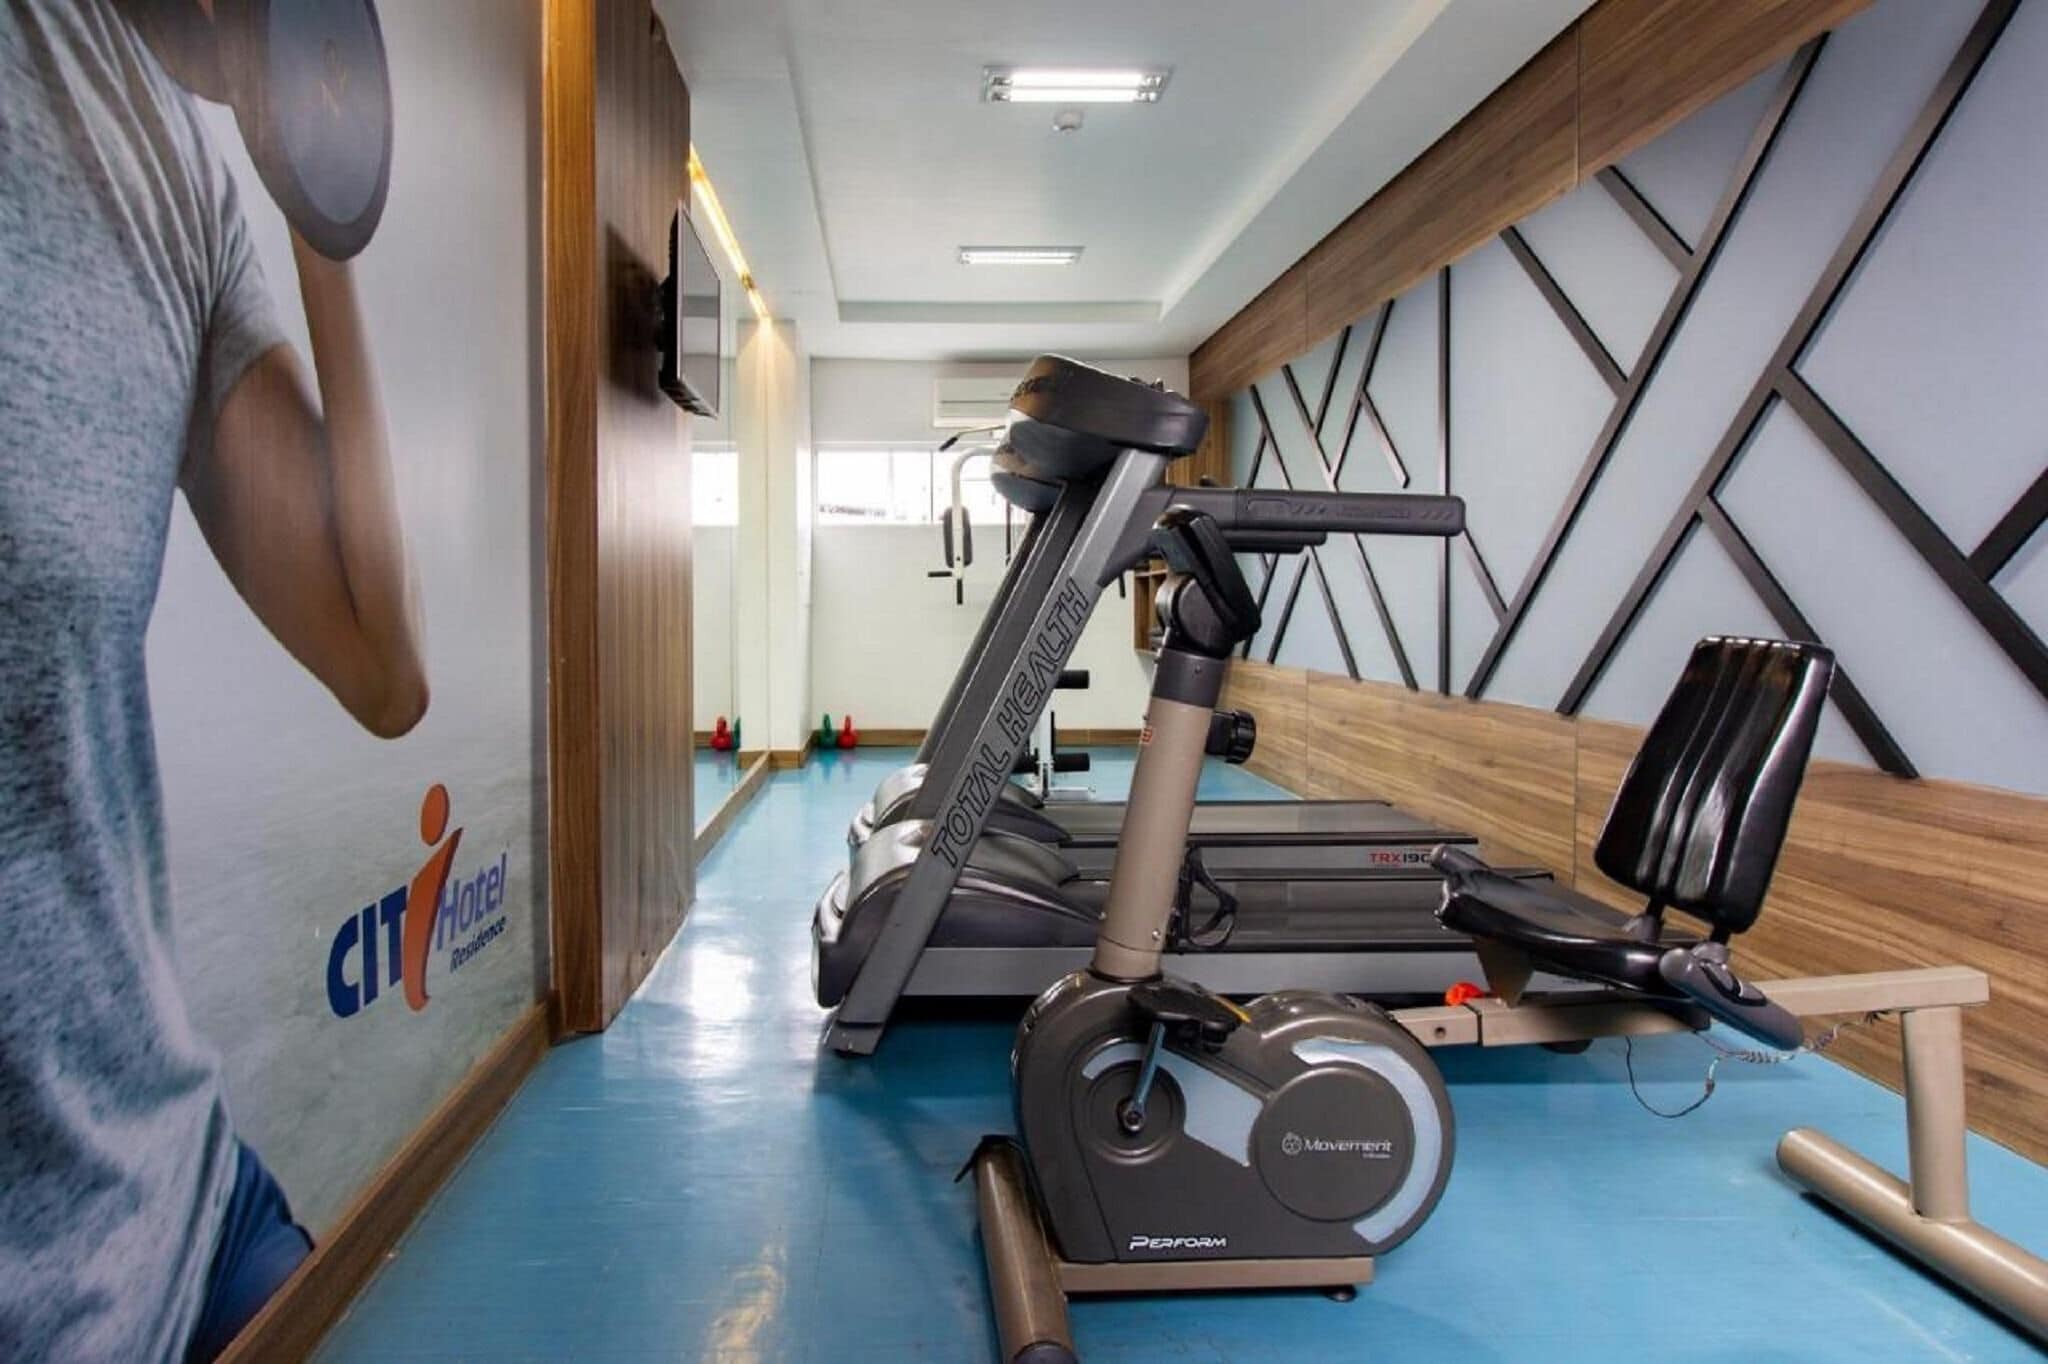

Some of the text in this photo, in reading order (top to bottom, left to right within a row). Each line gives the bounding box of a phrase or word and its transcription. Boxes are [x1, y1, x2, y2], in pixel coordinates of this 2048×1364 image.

[931, 576, 1089, 868] TOTAL HEALTH
[437, 852, 507, 951] Hotel
[450, 916, 506, 973] Residence
[1303, 1138, 1393, 1152] Movement
